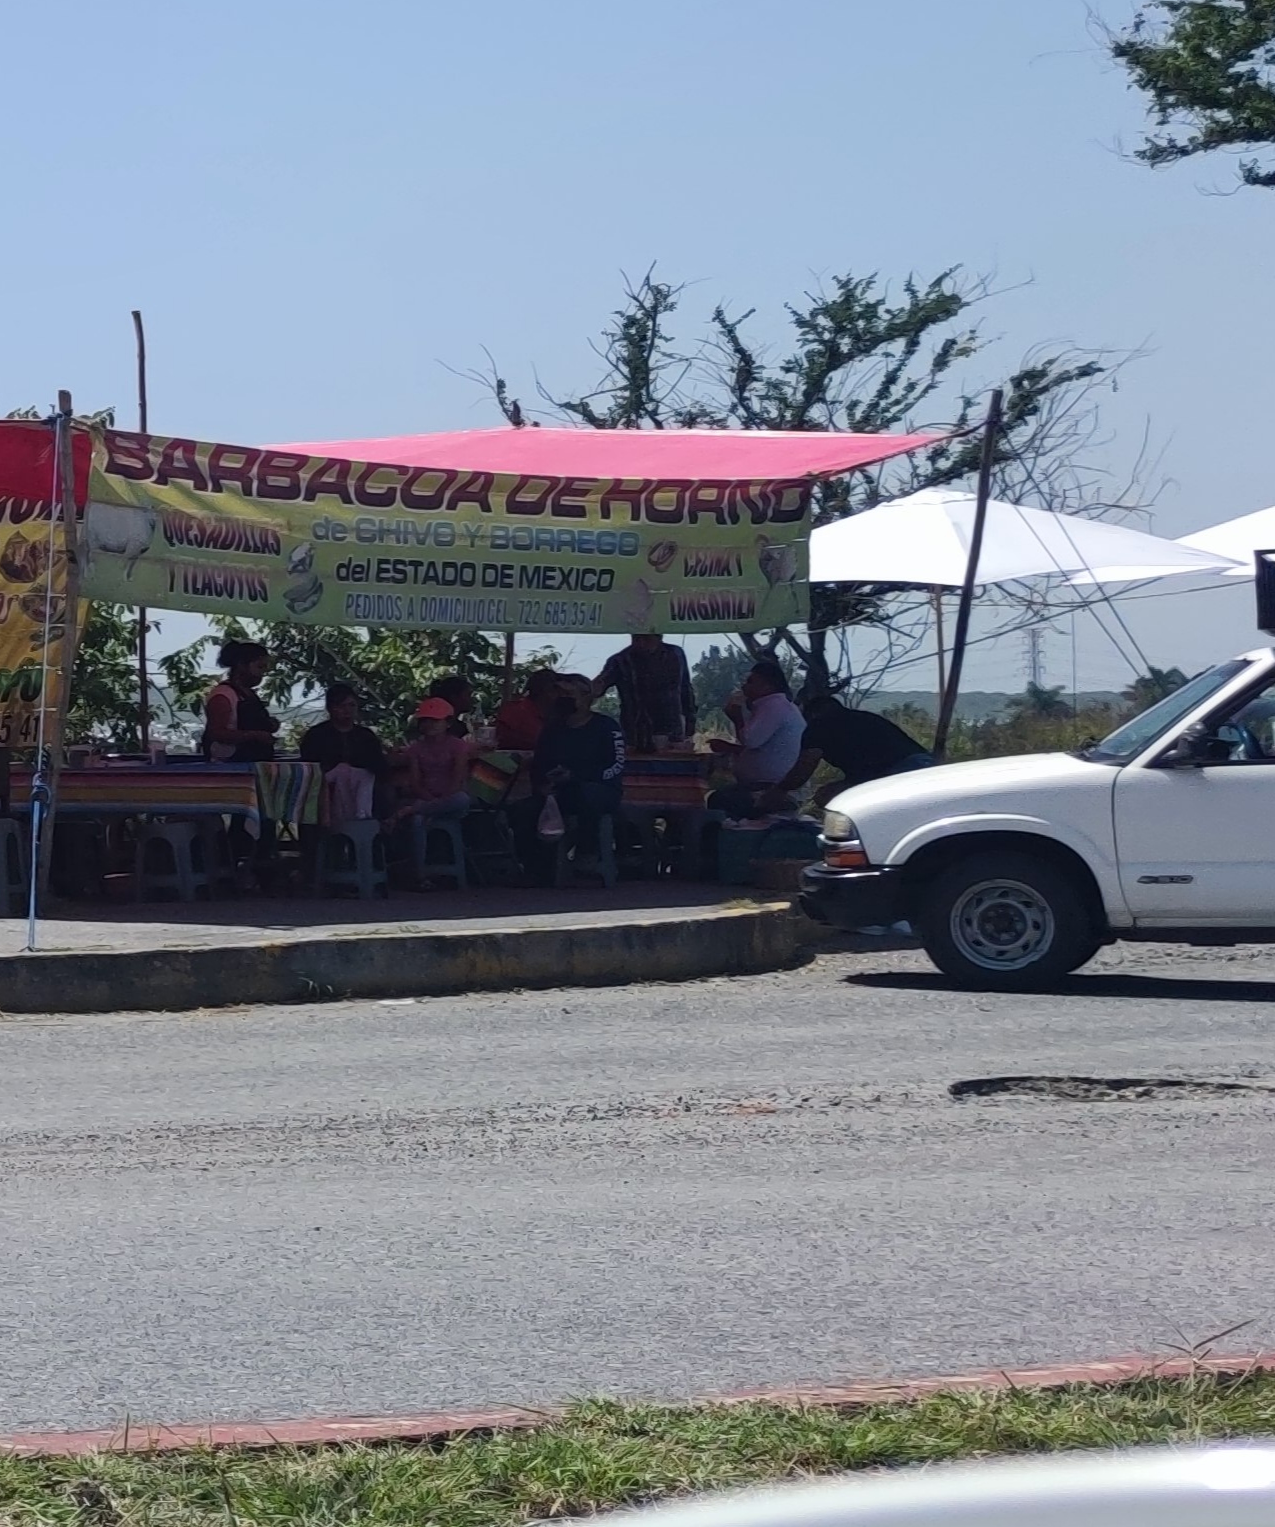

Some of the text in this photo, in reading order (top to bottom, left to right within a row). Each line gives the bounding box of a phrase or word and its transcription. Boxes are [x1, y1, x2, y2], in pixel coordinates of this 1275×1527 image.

[103, 429, 493, 513] BARBACOA
[505, 474, 597, 518] DE
[600, 478, 812, 525] HORNO
[312, 517, 640, 556] de CHIVO Y BORREGO
[336, 558, 615, 592] del ESTADO DE MEXICO
[346, 594, 402, 621] PEDIDOS
[407, 597, 415, 621] A
[420, 597, 486, 623] DOMICILIO
[518, 600, 541, 624] 722
